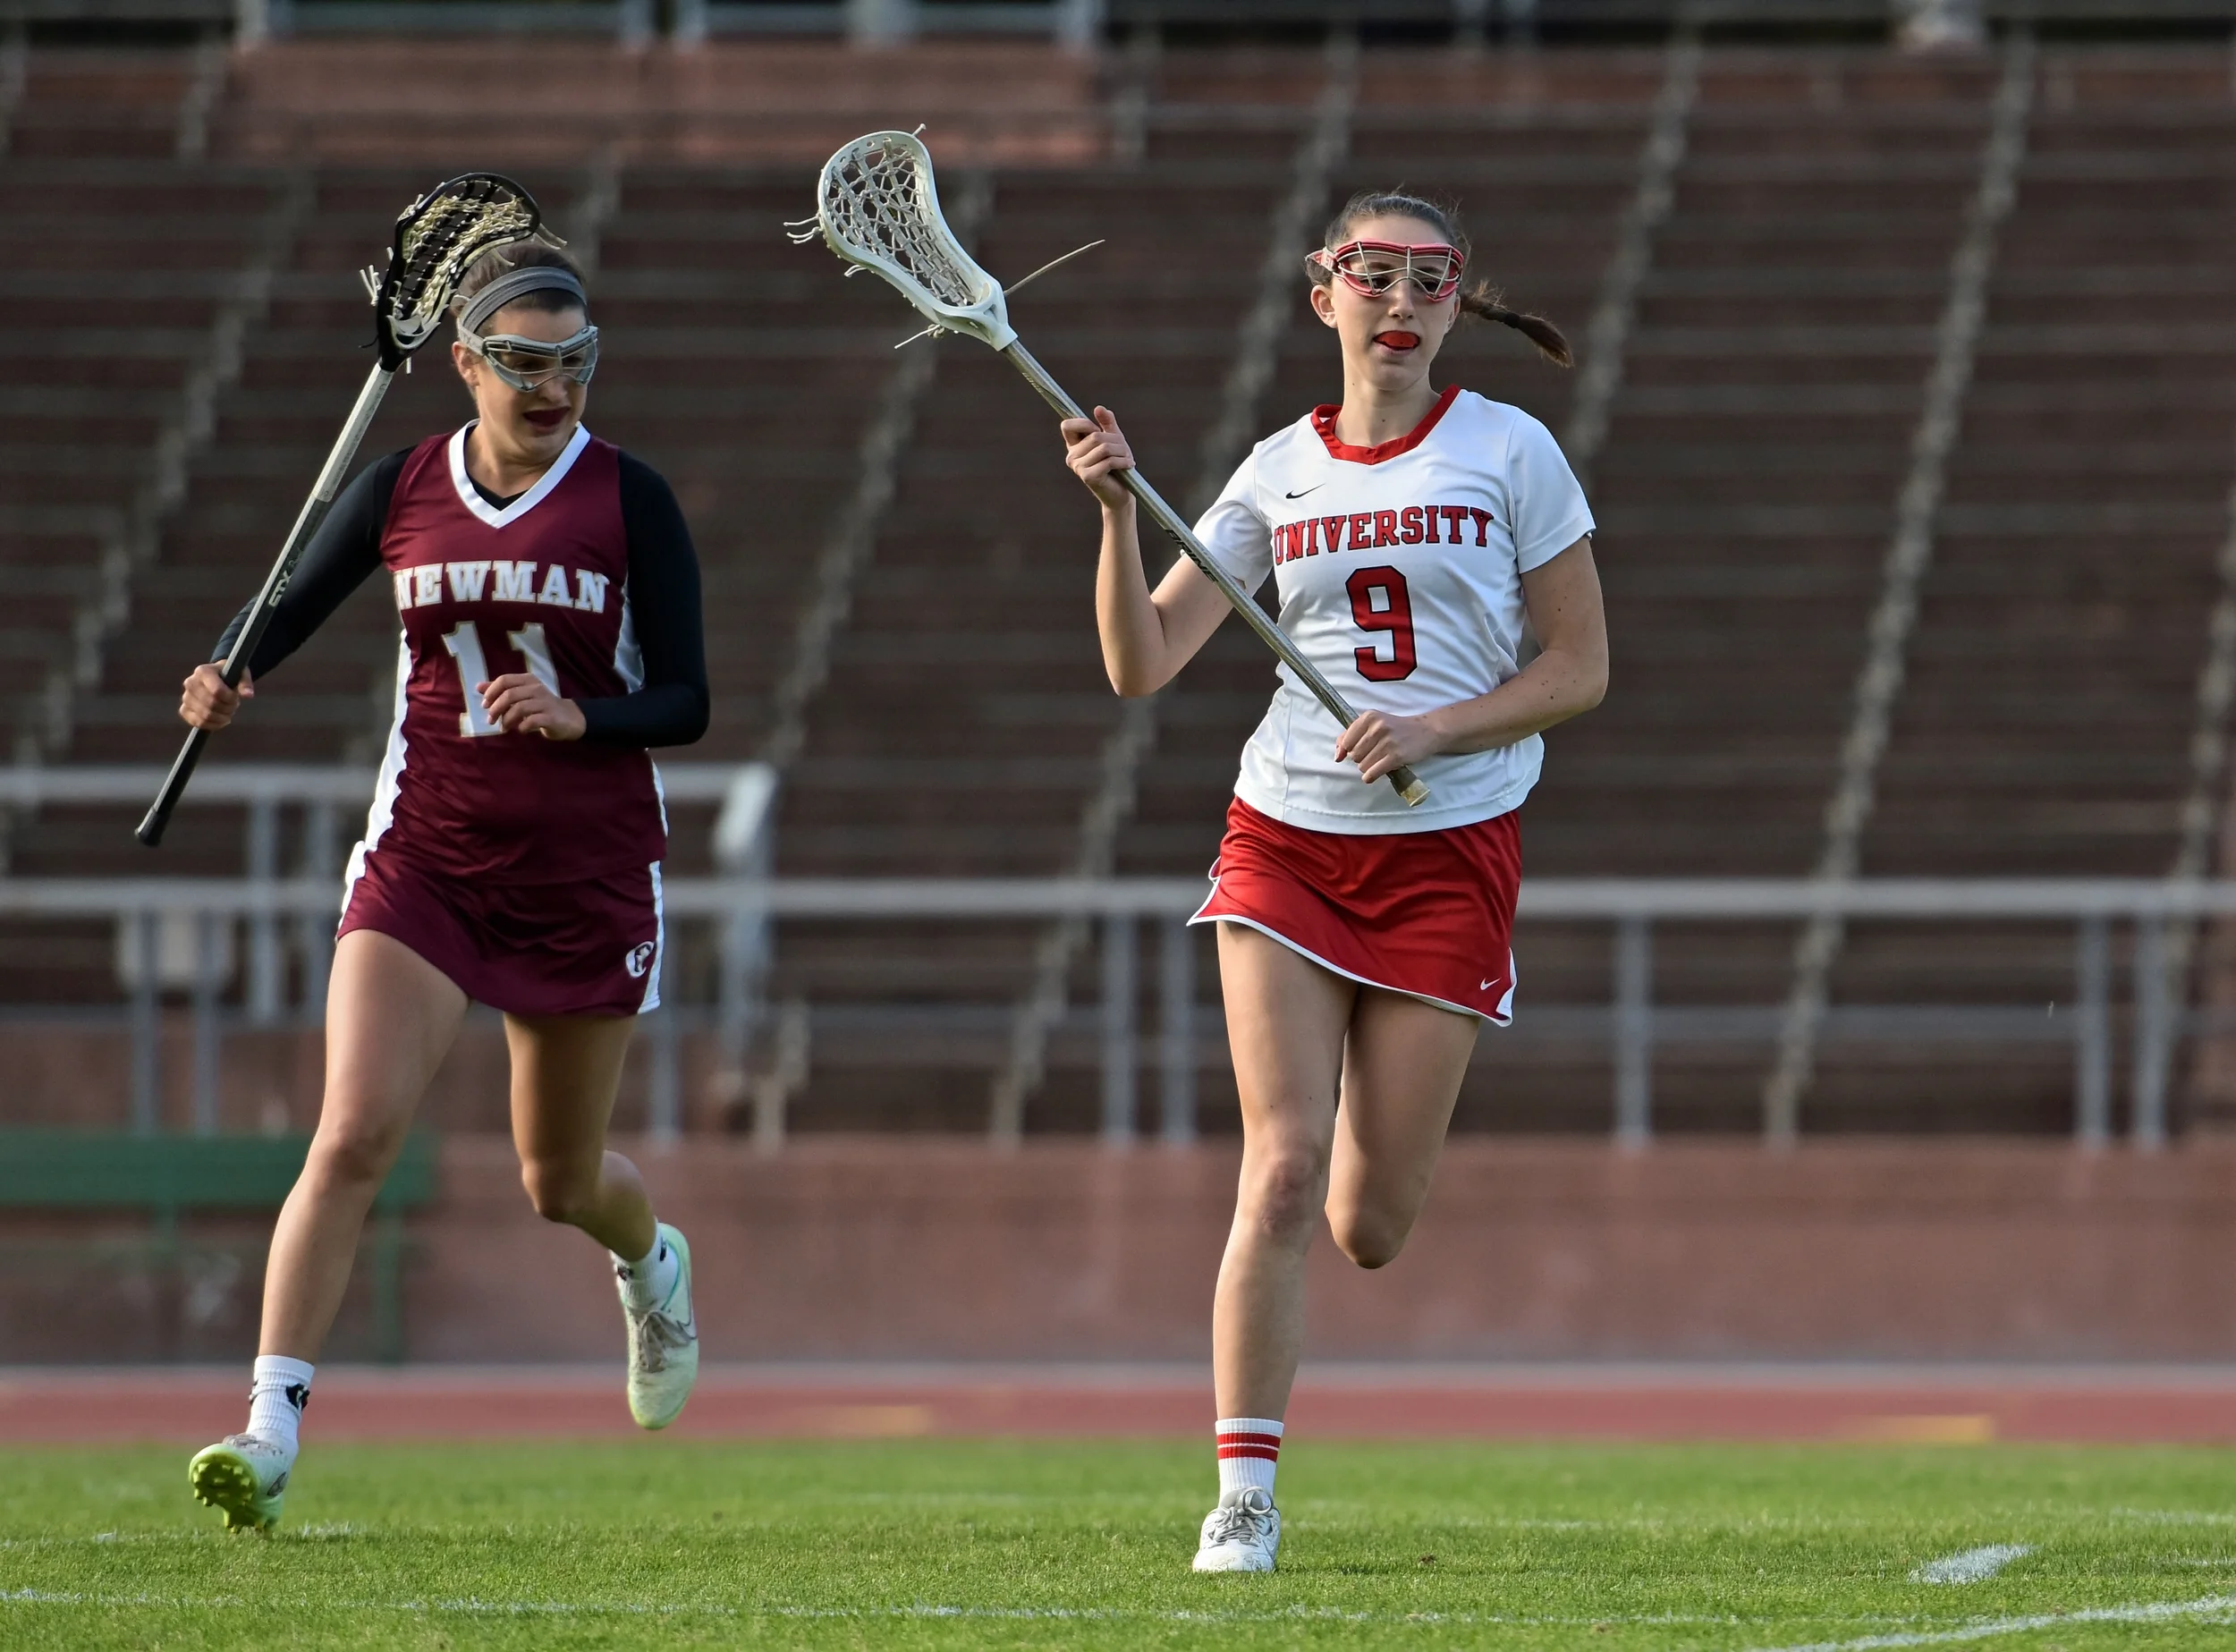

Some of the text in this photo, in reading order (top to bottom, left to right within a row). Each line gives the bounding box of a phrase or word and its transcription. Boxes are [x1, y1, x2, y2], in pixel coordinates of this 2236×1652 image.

[1165, 529, 1220, 582] BRINE
[1274, 504, 1495, 565] UNIVERSITY
[394, 560, 610, 614] NEWMAN
[1344, 565, 1418, 682] 9
[441, 621, 562, 738] 11
